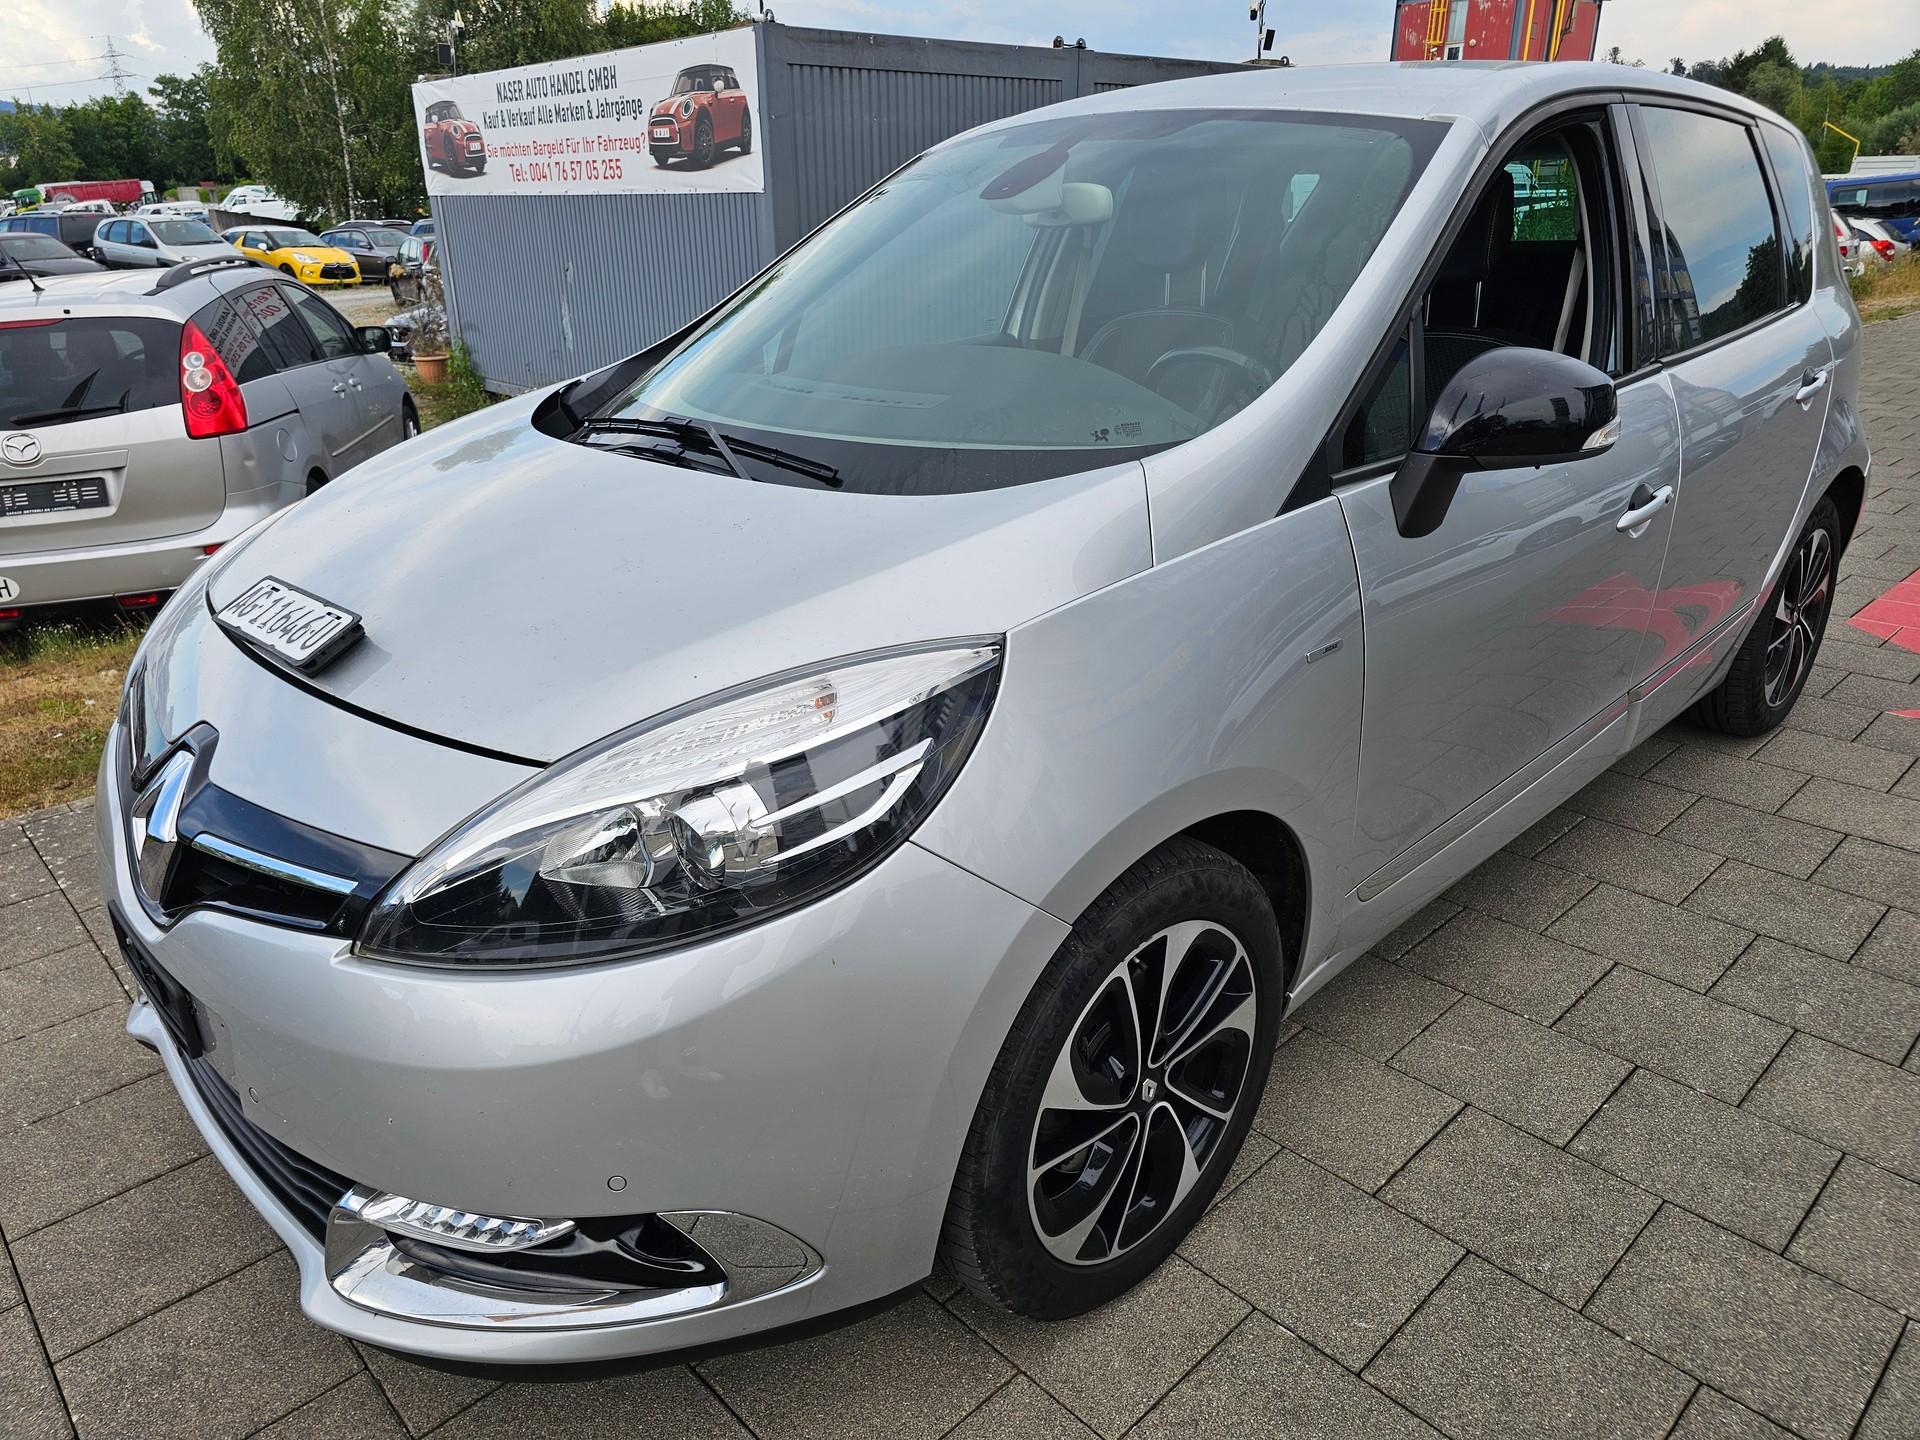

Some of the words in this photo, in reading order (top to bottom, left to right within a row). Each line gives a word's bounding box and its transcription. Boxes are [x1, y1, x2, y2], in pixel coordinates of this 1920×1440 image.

[496, 80, 524, 103] NASER
[526, 76, 548, 100] AUTO
[550, 70, 586, 97] HANDEL
[588, 65, 617, 91] GMBH
[482, 109, 499, 129] Kauf
[500, 110, 506, 128] &
[506, 105, 536, 127] Verkauf
[537, 104, 553, 125] Alle
[554, 101, 586, 123] Marken
[587, 99, 593, 119] &
[595, 95, 643, 122] Jahrgänge
[487, 143, 499, 158] Sie
[500, 141, 532, 157] möchten
[533, 135, 564, 159] Bargeld
[566, 137, 580, 154] Für
[582, 136, 595, 153] Ihr
[597, 132, 646, 154] Fahrzeug?
[509, 163, 528, 182] Tel:
[529, 162, 553, 182] 0041
[555, 161, 568, 181] 76
[570, 160, 582, 181] 57
[585, 159, 599, 180] 05
[601, 158, 623, 180] 255
